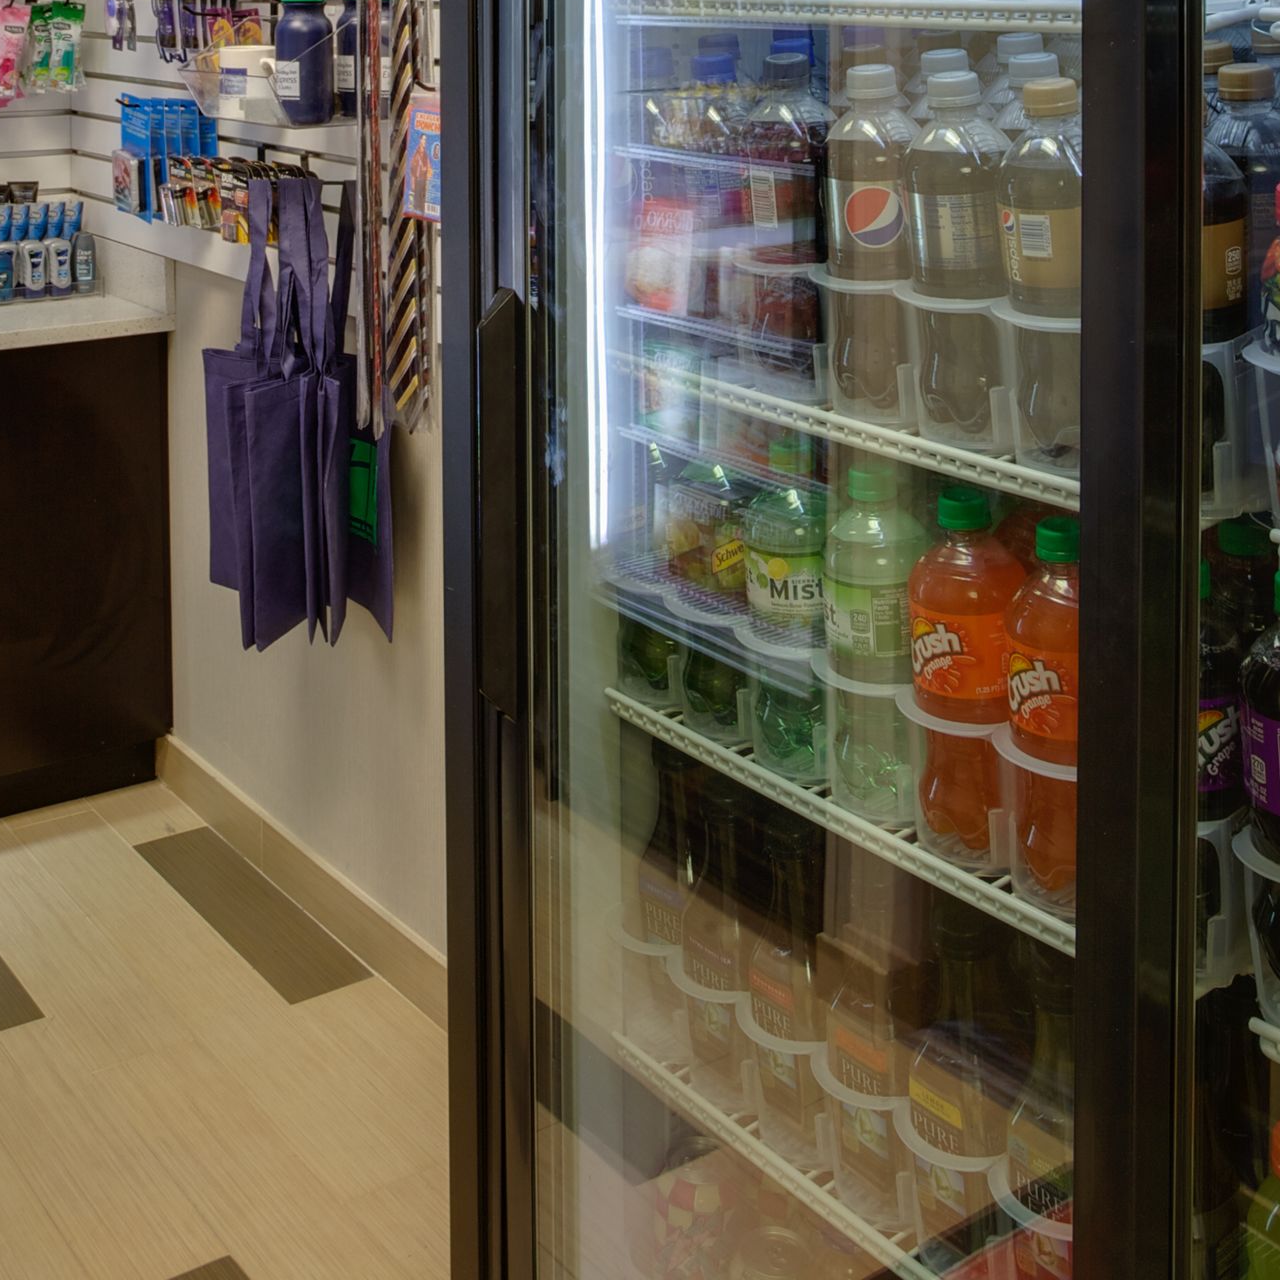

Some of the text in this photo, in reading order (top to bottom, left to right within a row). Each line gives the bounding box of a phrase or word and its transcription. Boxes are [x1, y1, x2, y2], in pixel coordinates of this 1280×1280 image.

[1008, 235, 1023, 282] pepsi
[911, 622, 962, 675] Crush
[1007, 660, 1062, 713] Crush
[1207, 741, 1237, 776] Grape
[753, 998, 791, 1032] PURE
[841, 1058, 882, 1093] PURE
[913, 1110, 959, 1150] PURE
[1016, 1170, 1064, 1213] PURE
